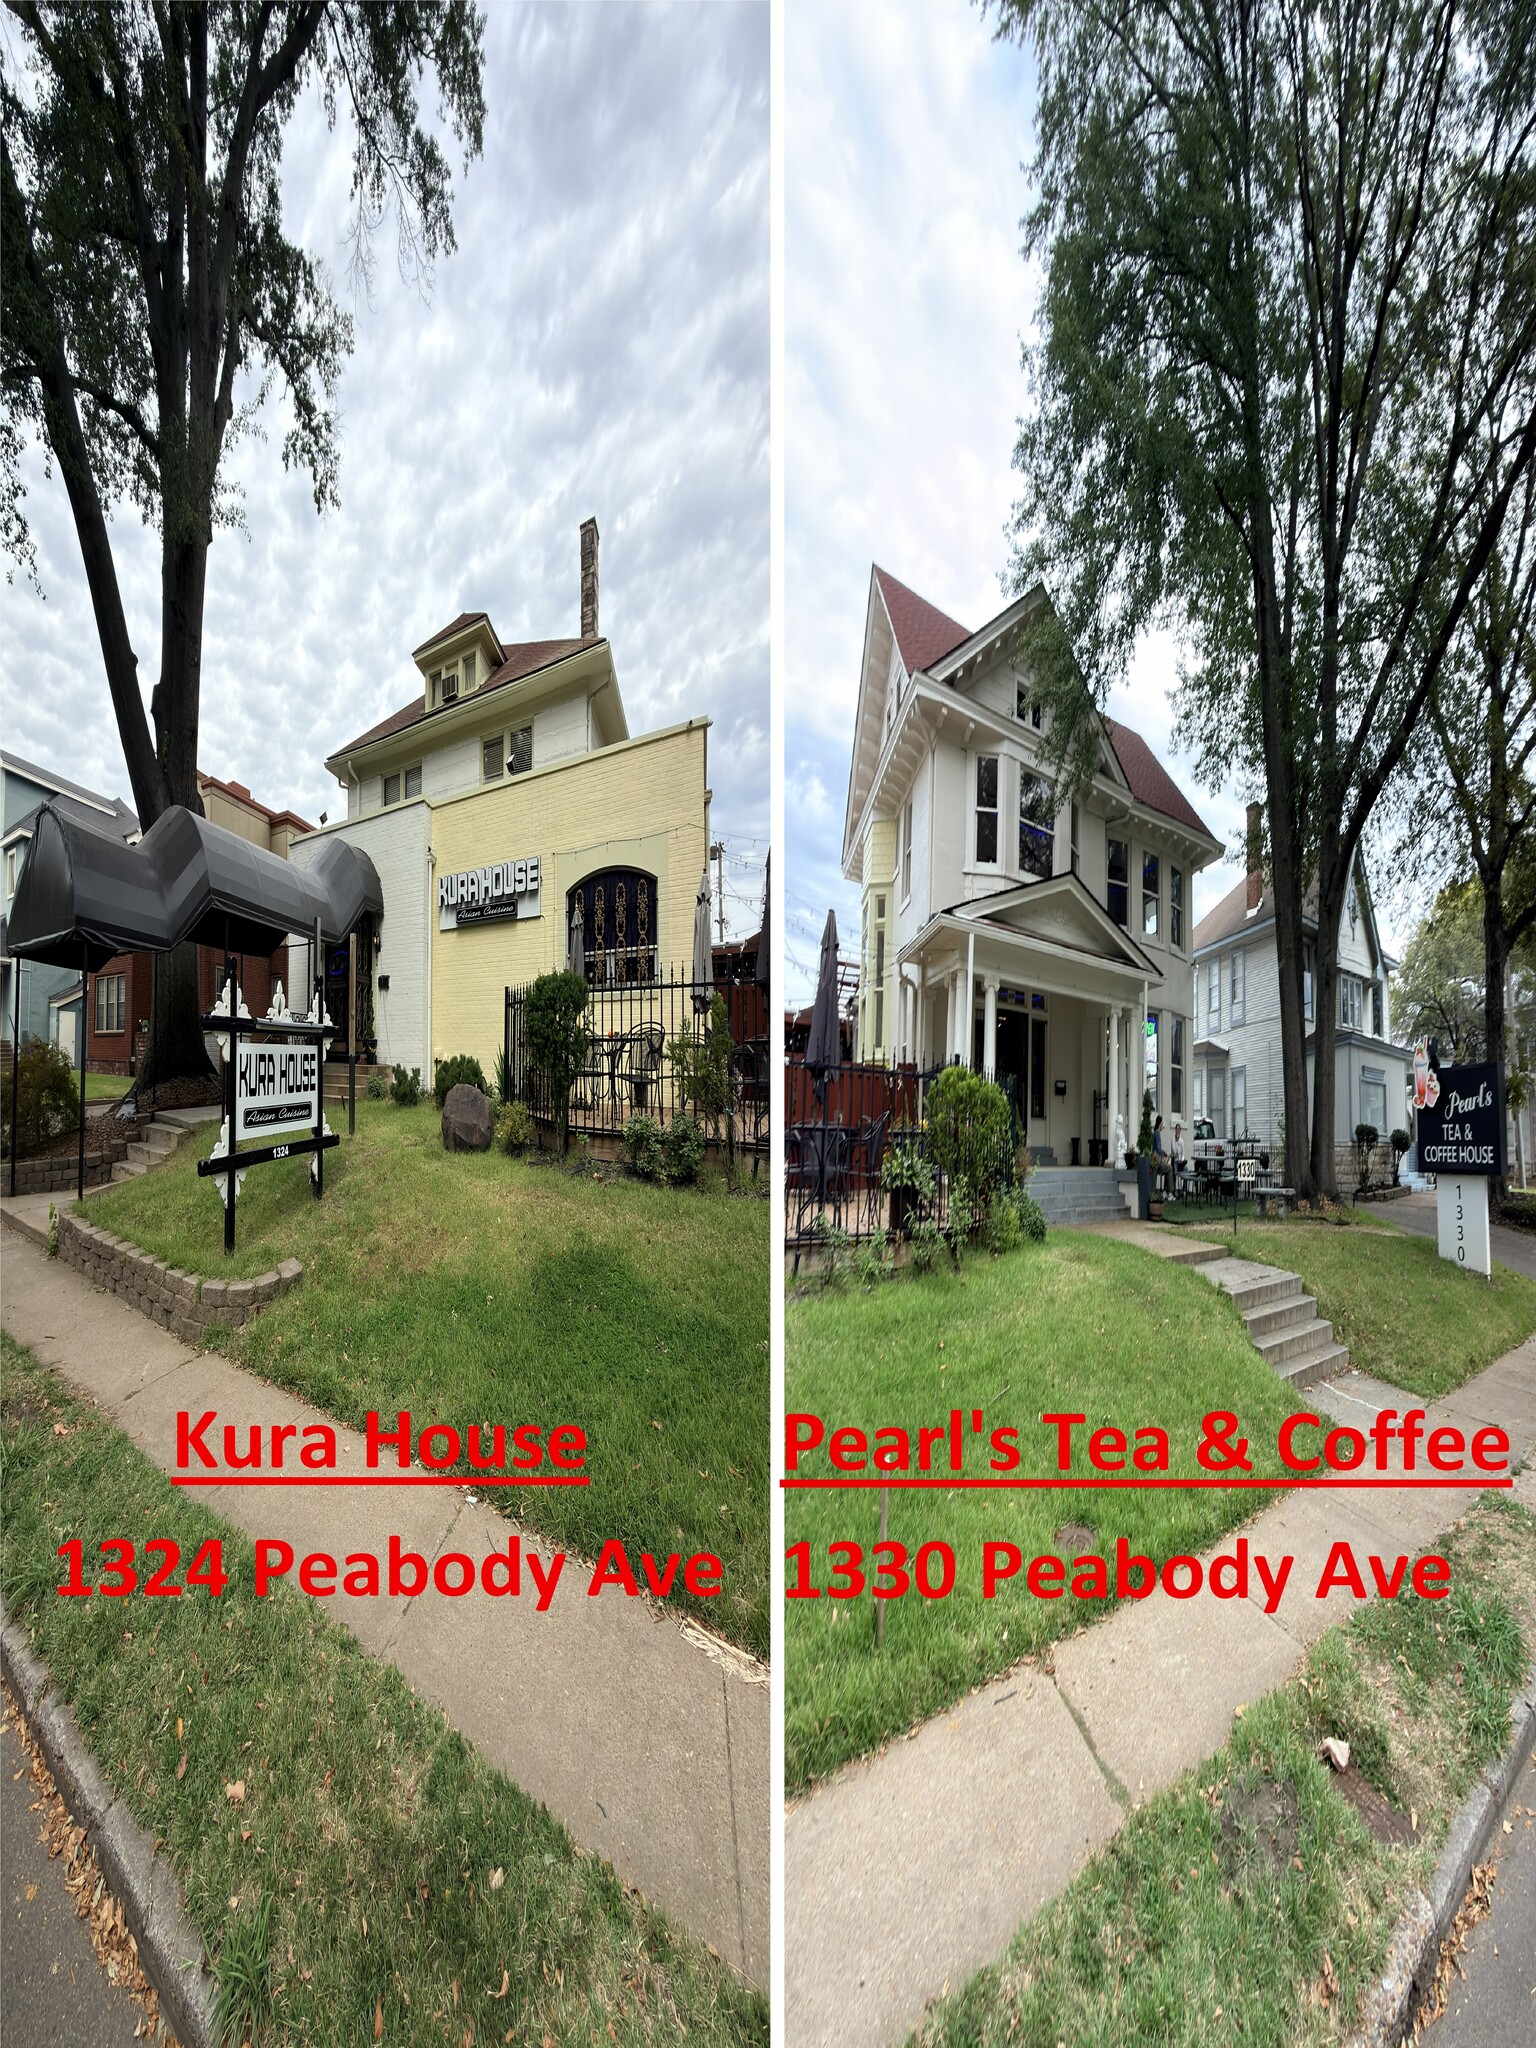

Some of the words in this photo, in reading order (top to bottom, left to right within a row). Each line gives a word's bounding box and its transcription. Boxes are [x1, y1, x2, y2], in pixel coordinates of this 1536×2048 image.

[438, 870, 480, 907] KURA
[481, 857, 539, 898] HOUSE
[457, 910, 481, 920] Asian
[483, 904, 514, 915] Cuisine
[239, 1053, 275, 1098] KURA
[280, 1053, 316, 1094] HOUSE
[1445, 1081, 1493, 1120] Pearl's
[246, 1111, 276, 1123] Asian
[278, 1107, 310, 1119] Cuisine
[1441, 1123, 1462, 1141] TEA
[1464, 1123, 1473, 1141] &
[273, 1145, 289, 1158] 1324
[1424, 1146, 1457, 1162] COFFEE
[1459, 1146, 1494, 1164] HOUSE
[1238, 1161, 1255, 1178] 1330
